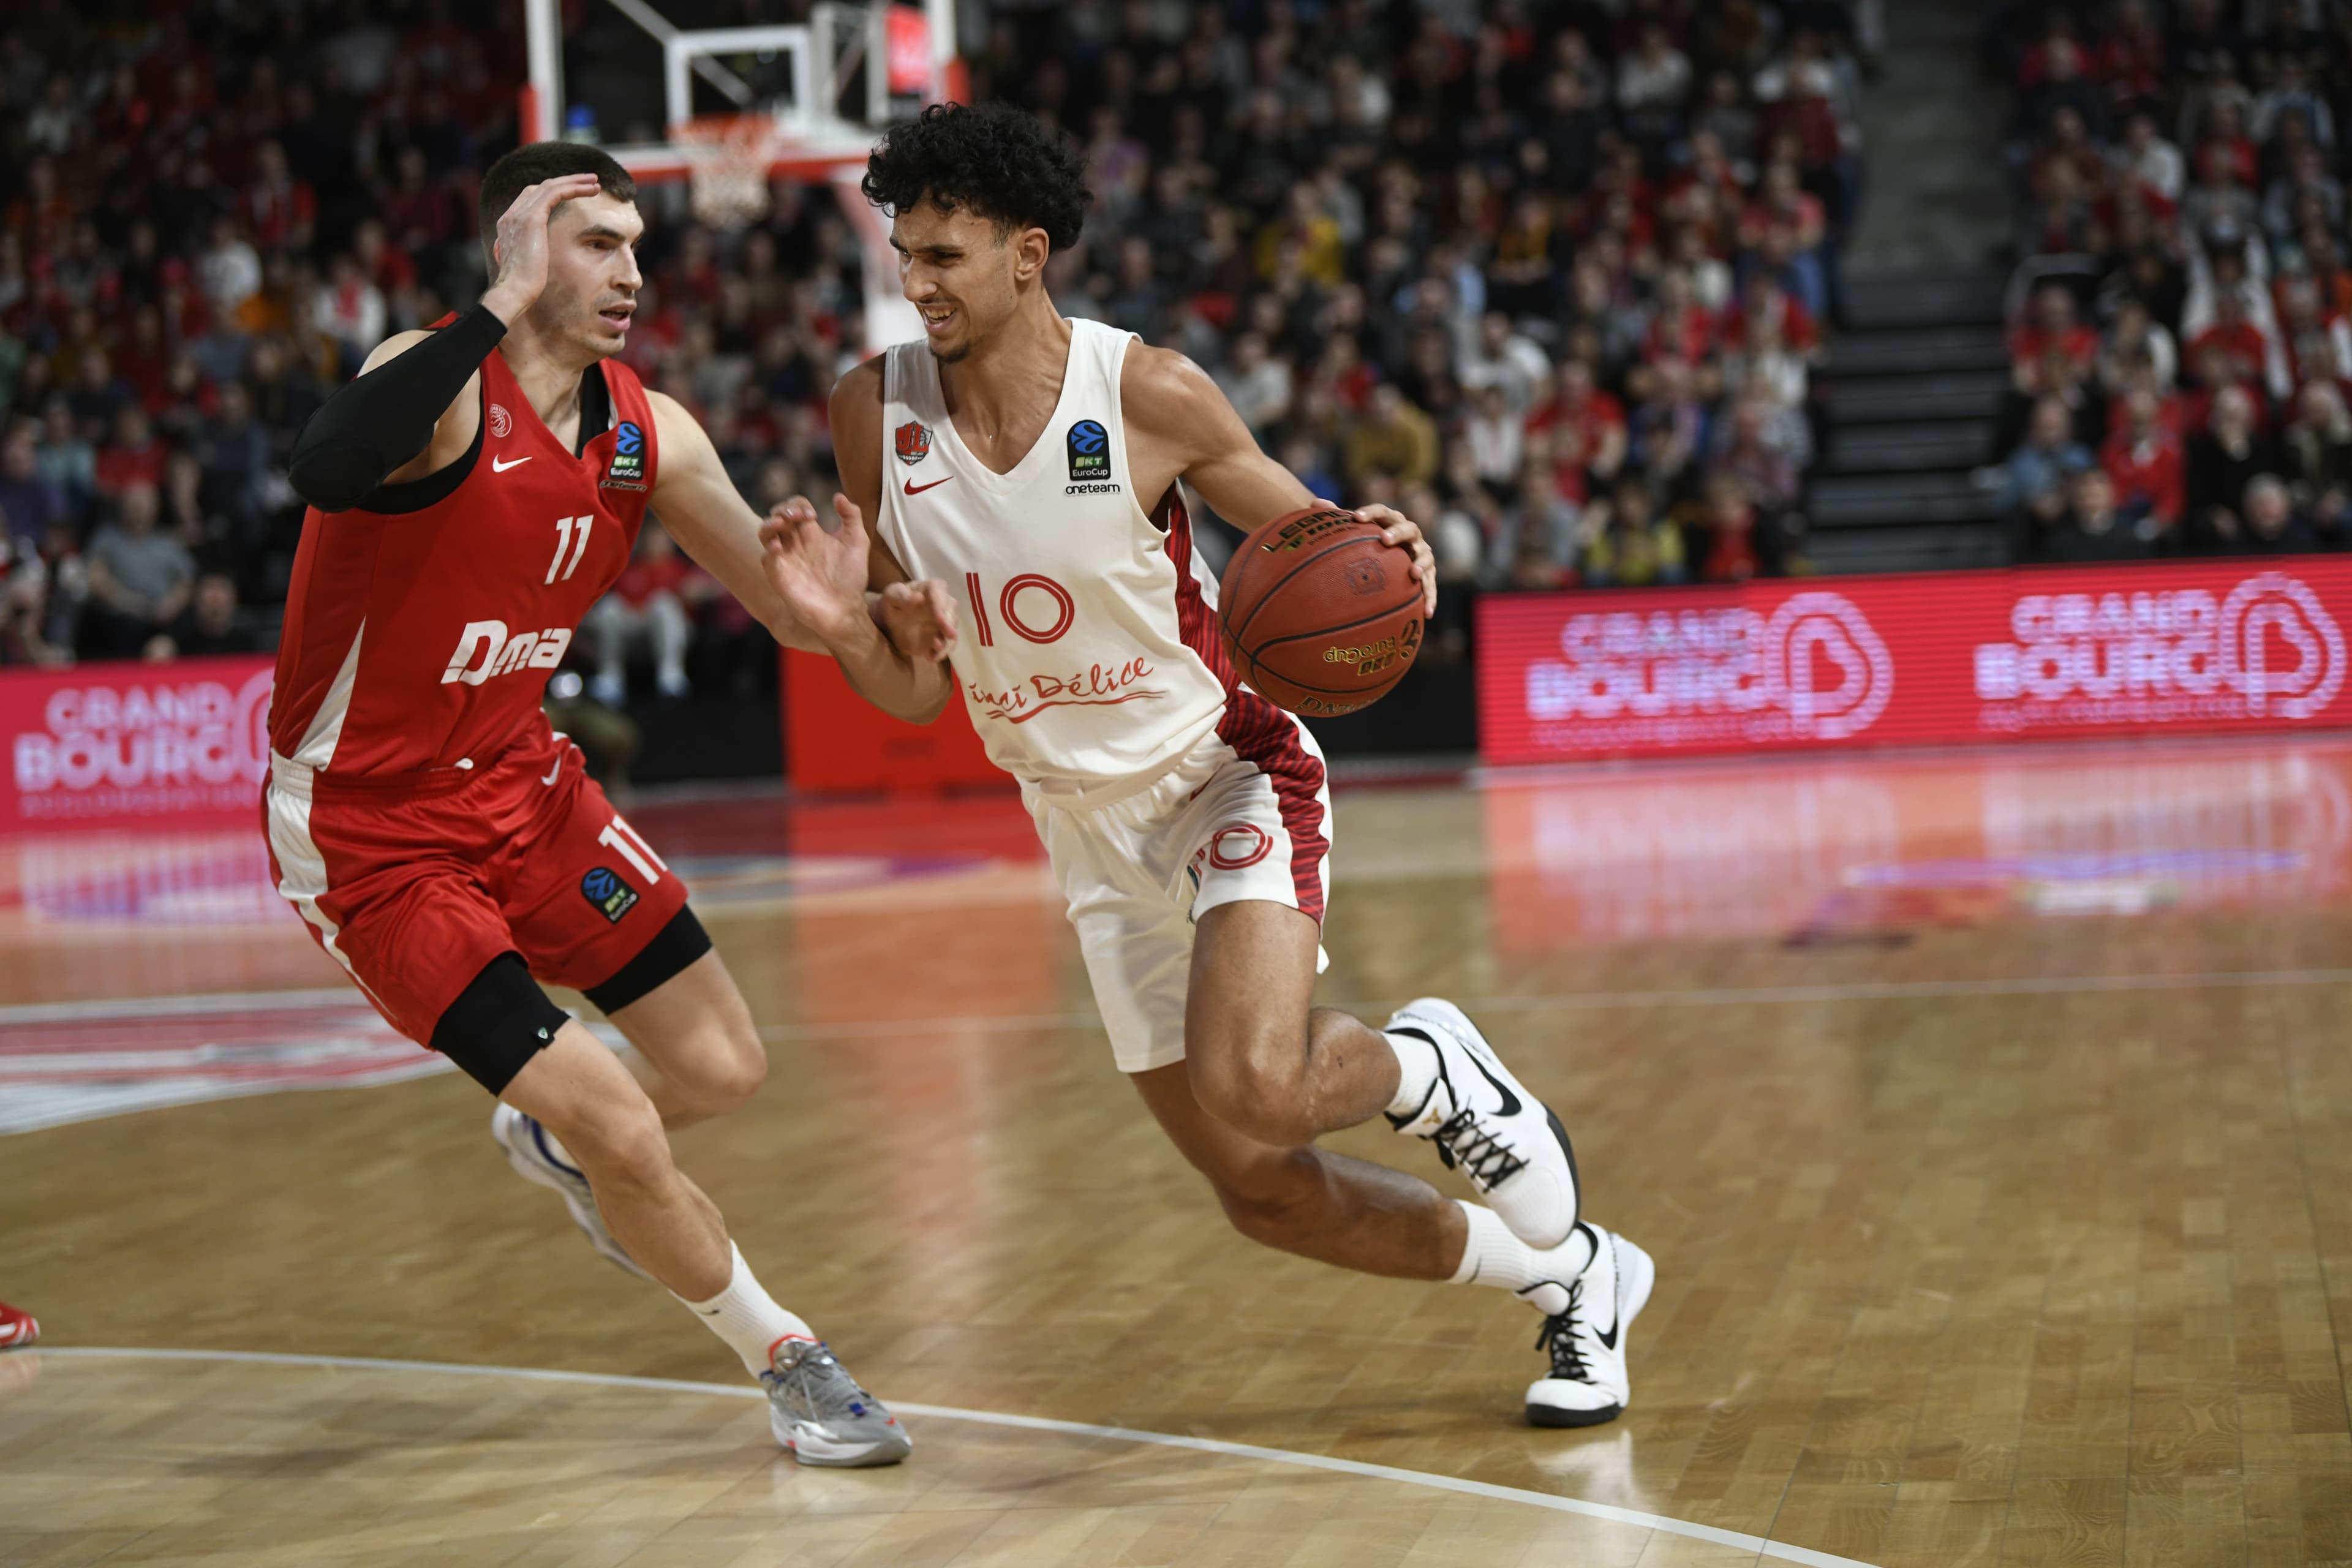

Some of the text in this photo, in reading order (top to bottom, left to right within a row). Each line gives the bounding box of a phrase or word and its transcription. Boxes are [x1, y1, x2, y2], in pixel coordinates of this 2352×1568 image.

[1066, 483, 1120, 495] oneteam
[1072, 468, 1108, 477] EuroCup
[544, 514, 594, 585] 11
[965, 572, 1075, 647] 10
[1030, 657, 1154, 698] Délice
[598, 815, 668, 886] 11
